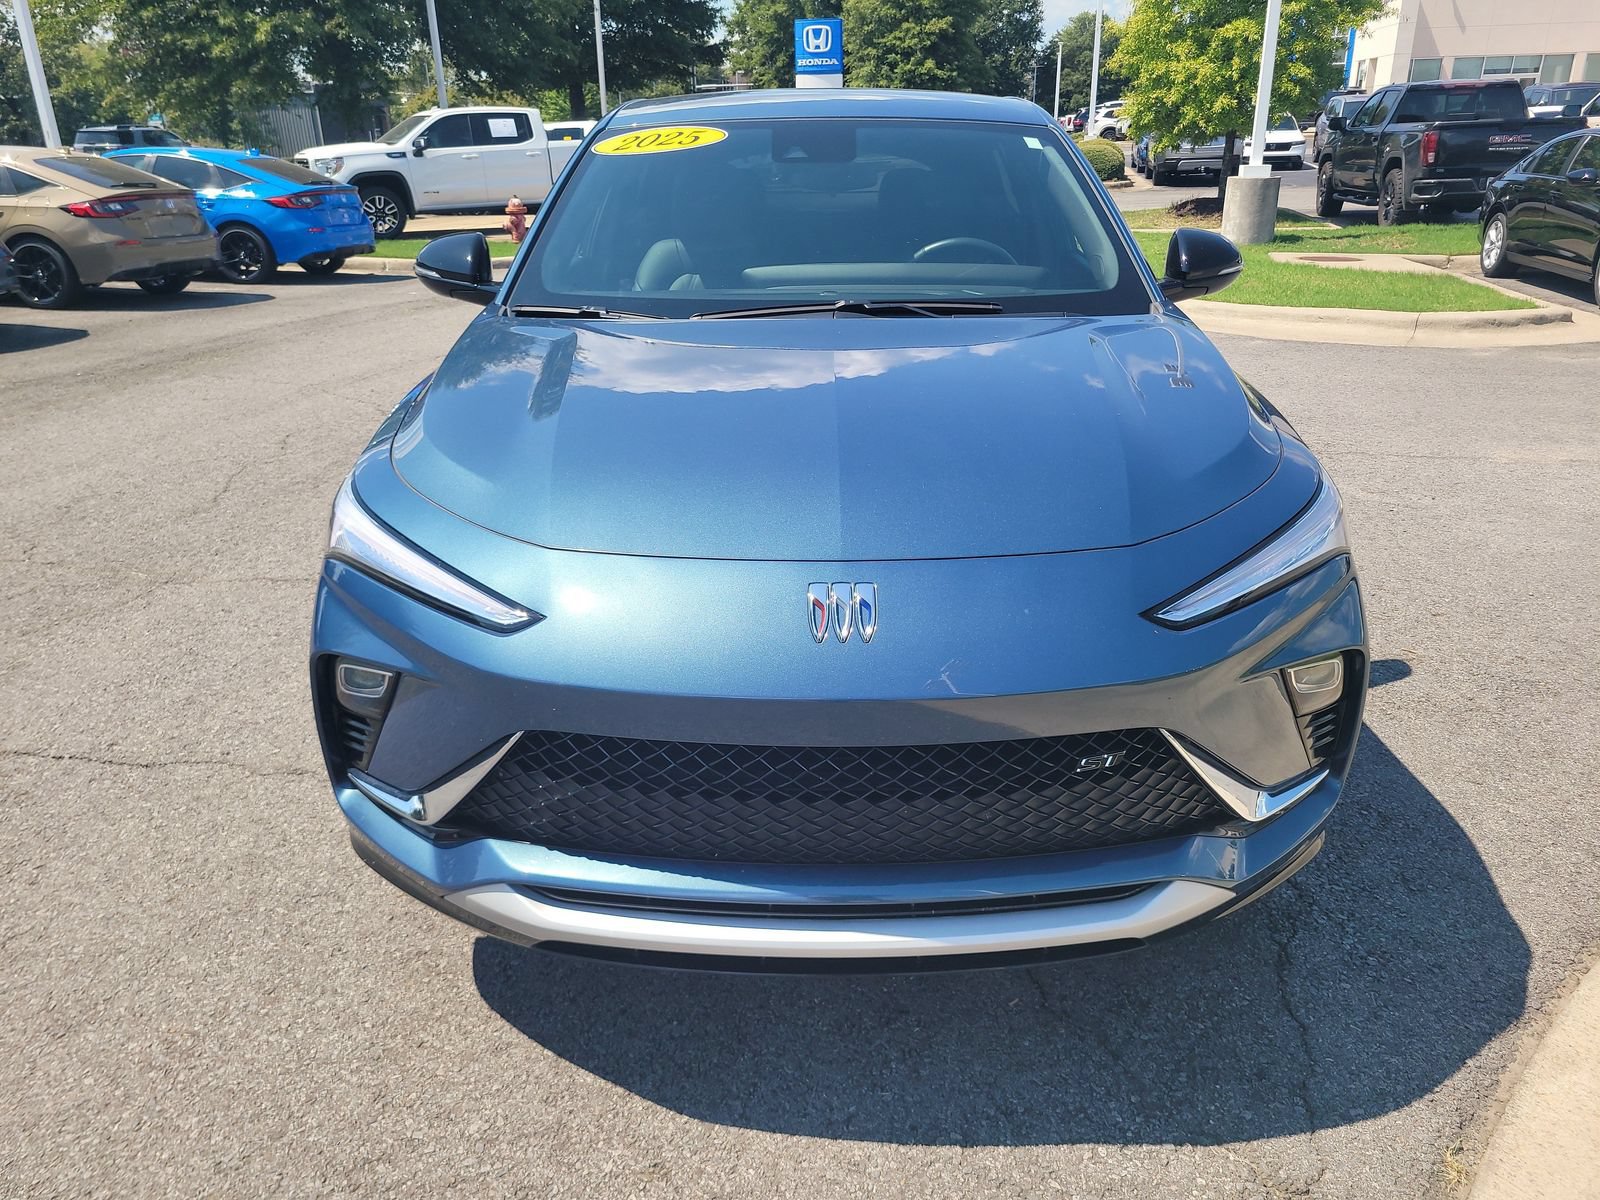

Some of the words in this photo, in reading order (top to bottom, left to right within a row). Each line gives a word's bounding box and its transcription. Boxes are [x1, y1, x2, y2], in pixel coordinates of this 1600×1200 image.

[797, 58, 839, 66] HONDA
[612, 130, 707, 152] 2025
[1489, 134, 1532, 144] GMC
[1076, 750, 1126, 772] ST
